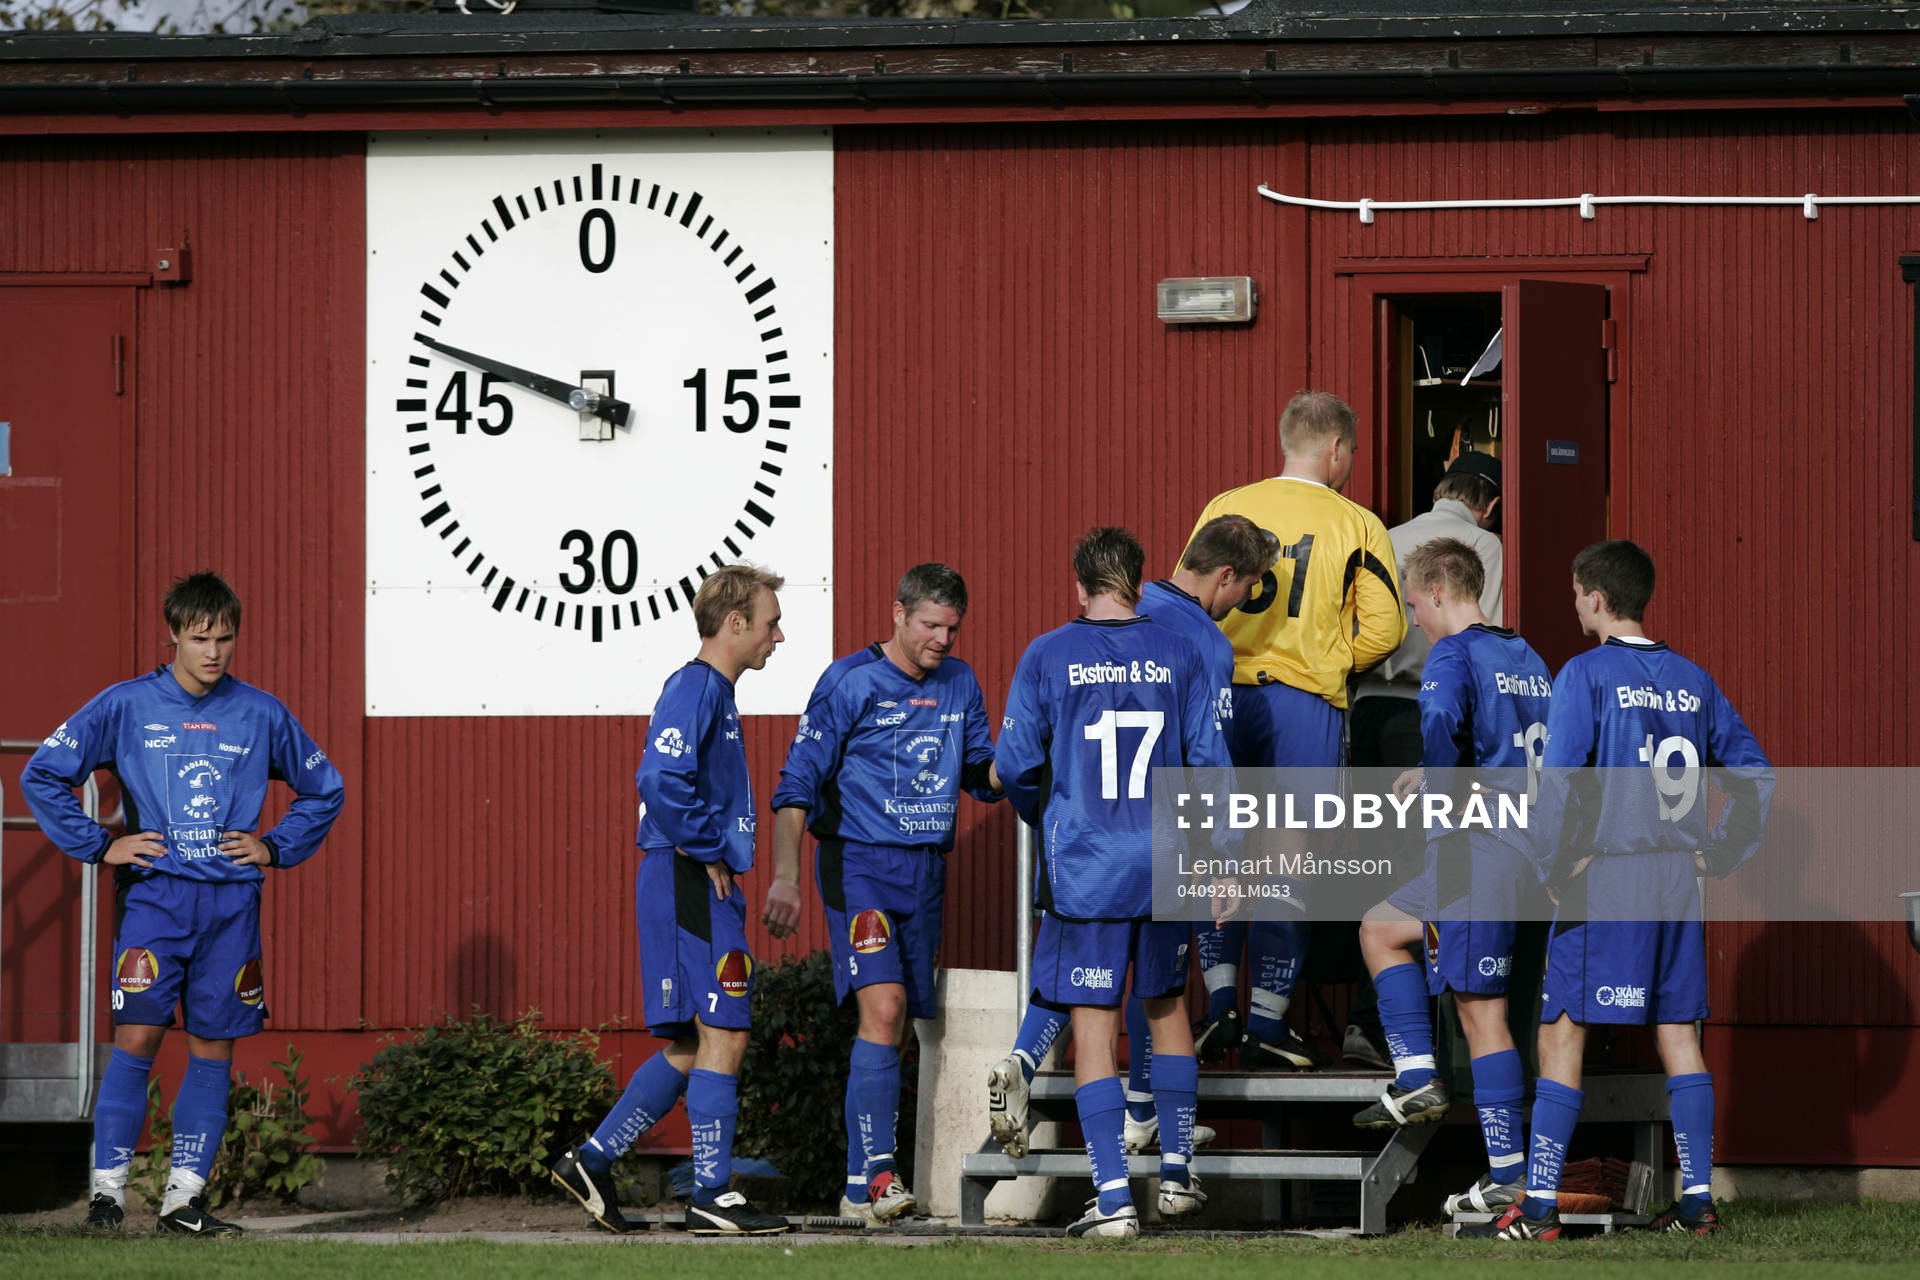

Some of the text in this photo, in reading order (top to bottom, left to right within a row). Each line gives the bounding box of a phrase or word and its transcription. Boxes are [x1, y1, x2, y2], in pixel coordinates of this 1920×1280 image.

[578, 208, 616, 273] 0
[435, 370, 513, 435] 45
[683, 368, 760, 433] 15
[559, 529, 638, 594] 30
[1068, 660, 1171, 687] Ekström & Son
[1529, 675, 1540, 697] &
[1665, 689, 1678, 713] &
[1678, 688, 1702, 714] Son
[876, 717, 900, 727] NCC
[144, 739, 169, 749] NCC
[1084, 709, 1165, 800] 17
[1638, 733, 1700, 824] 19
[855, 940, 863, 948] TK
[863, 938, 877, 946] OST
[849, 956, 858, 976] 5
[1085, 966, 1113, 981] SKÅNE
[722, 980, 732, 988] TK
[732, 980, 744, 988] OST
[1085, 979, 1113, 990] MEJERIER
[1615, 984, 1646, 999] SKÅNE
[707, 992, 719, 1013] 7
[1177, 1106, 1189, 1154] SPORTIA
[1478, 1107, 1501, 1148] TEAM
[699, 1118, 721, 1179] TEAM
[1532, 1133, 1553, 1186] TEAM
[1676, 1132, 1694, 1179] SPORTIA
[1547, 1142, 1565, 1190] SPORTIA
